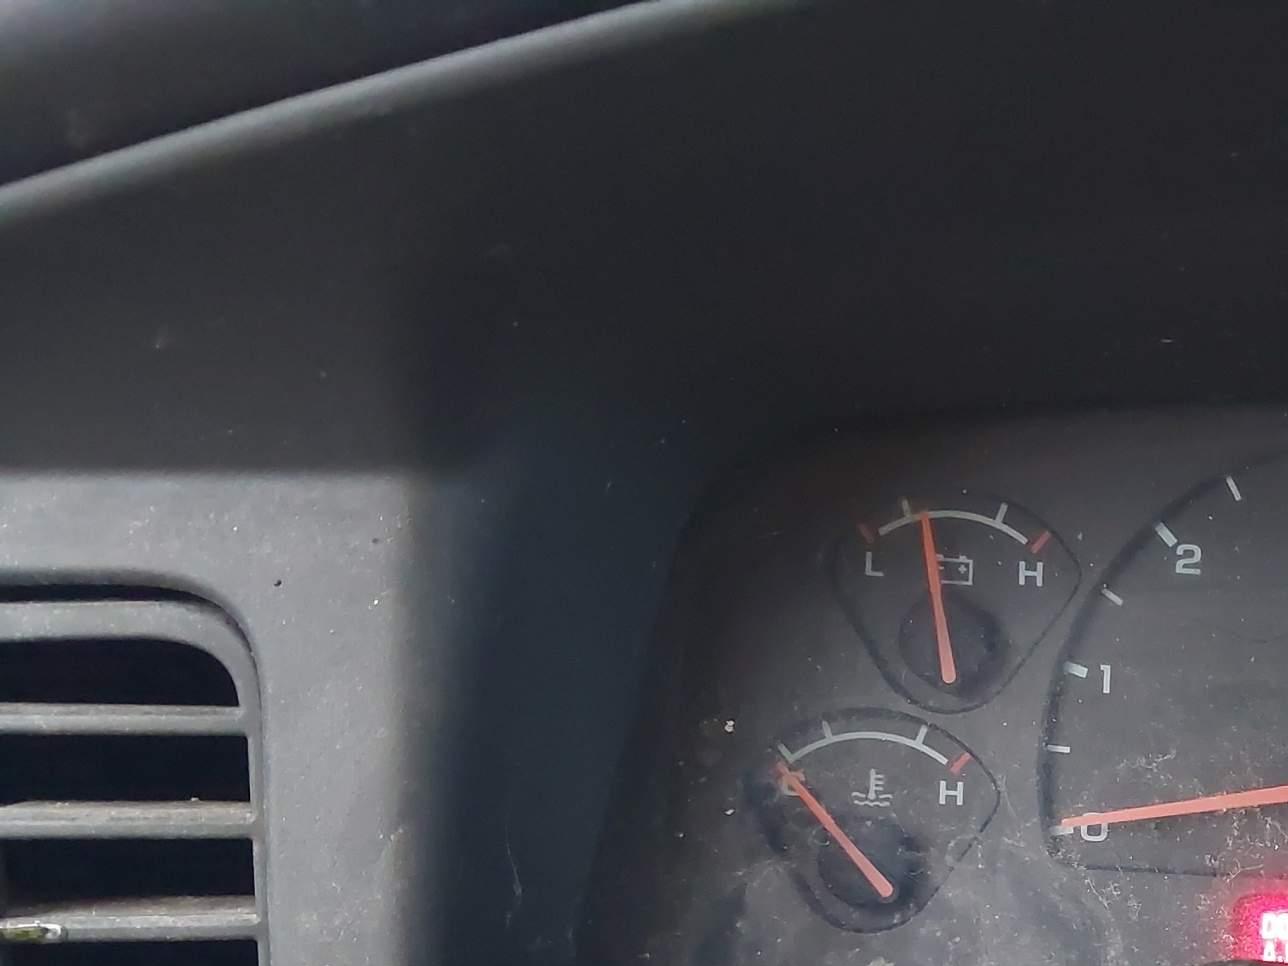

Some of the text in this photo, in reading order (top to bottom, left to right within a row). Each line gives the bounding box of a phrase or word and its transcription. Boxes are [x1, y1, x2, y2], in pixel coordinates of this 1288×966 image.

[865, 552, 884, 577] L
[1175, 544, 1201, 575] 2
[1018, 561, 1044, 587] H
[1100, 665, 1112, 694] 1
[938, 781, 964, 805] H
[1080, 812, 1109, 842] 0
